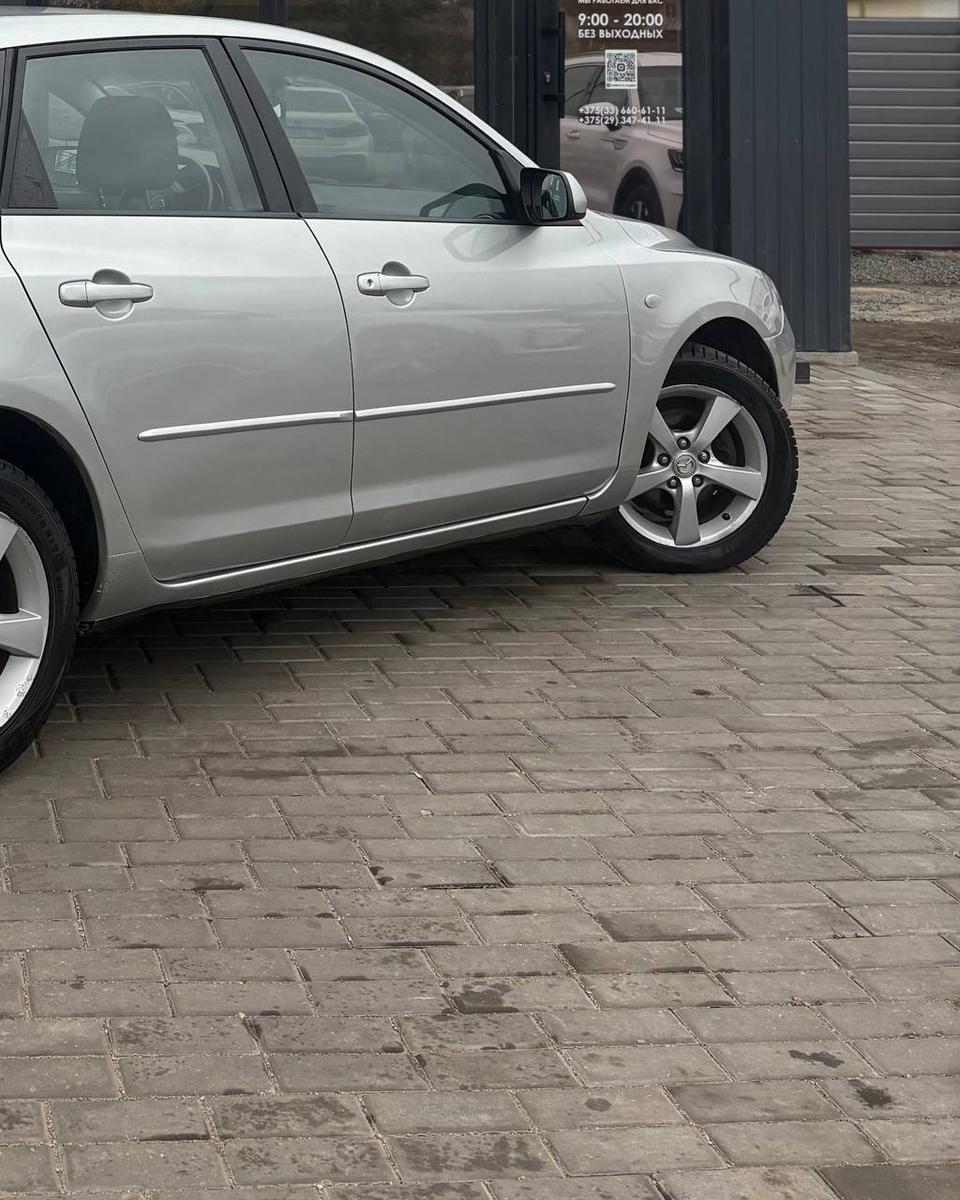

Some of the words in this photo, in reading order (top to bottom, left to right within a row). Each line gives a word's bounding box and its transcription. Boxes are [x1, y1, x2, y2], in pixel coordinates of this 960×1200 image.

[578, 13, 609, 26] 9:00
[623, 13, 664, 26] 20:00
[578, 29, 596, 39] БЕЗ
[598, 29, 664, 40] ВЫХОДНЫХ
[578, 106, 619, 116] +375(33)
[620, 106, 666, 115] 660-61-11
[578, 116, 619, 126] +375(29)
[620, 116, 666, 125] 347-4111
